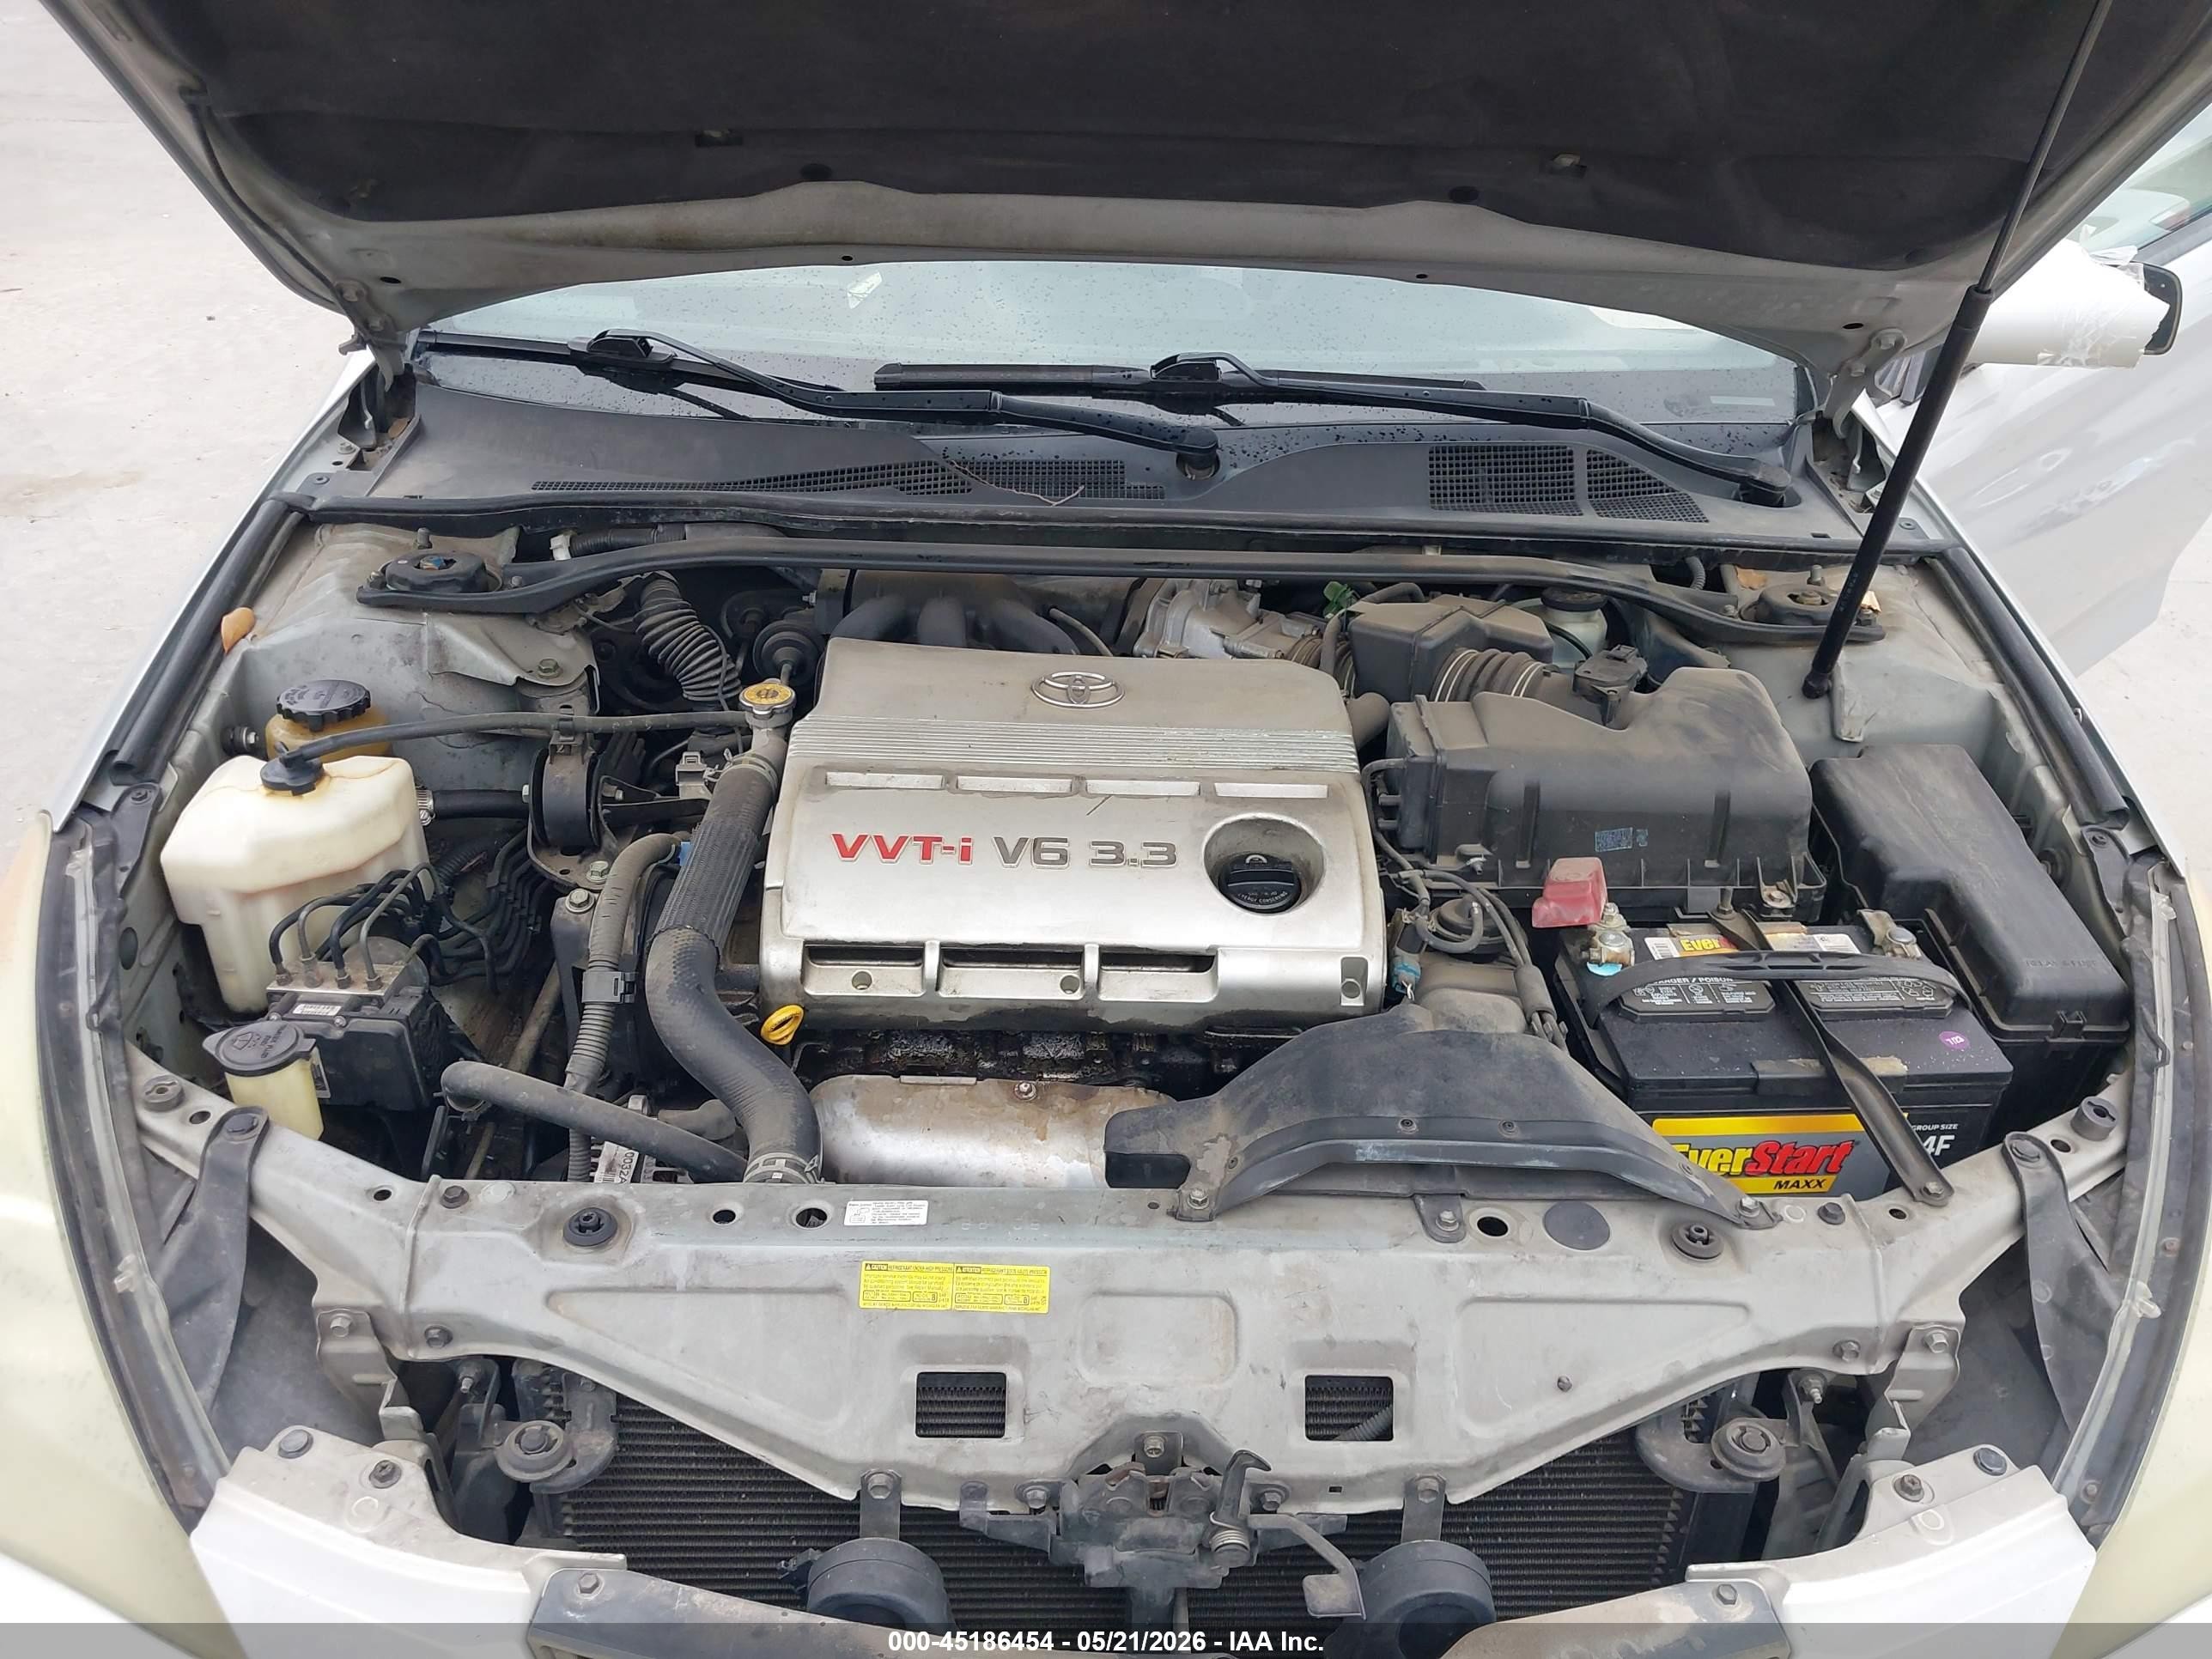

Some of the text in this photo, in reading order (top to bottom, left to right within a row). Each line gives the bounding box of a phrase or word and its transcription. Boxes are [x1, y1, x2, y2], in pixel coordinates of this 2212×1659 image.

[830, 833, 1177, 869] VVT-i V6 3.3
[1773, 1179, 1826, 1190] MAXX
